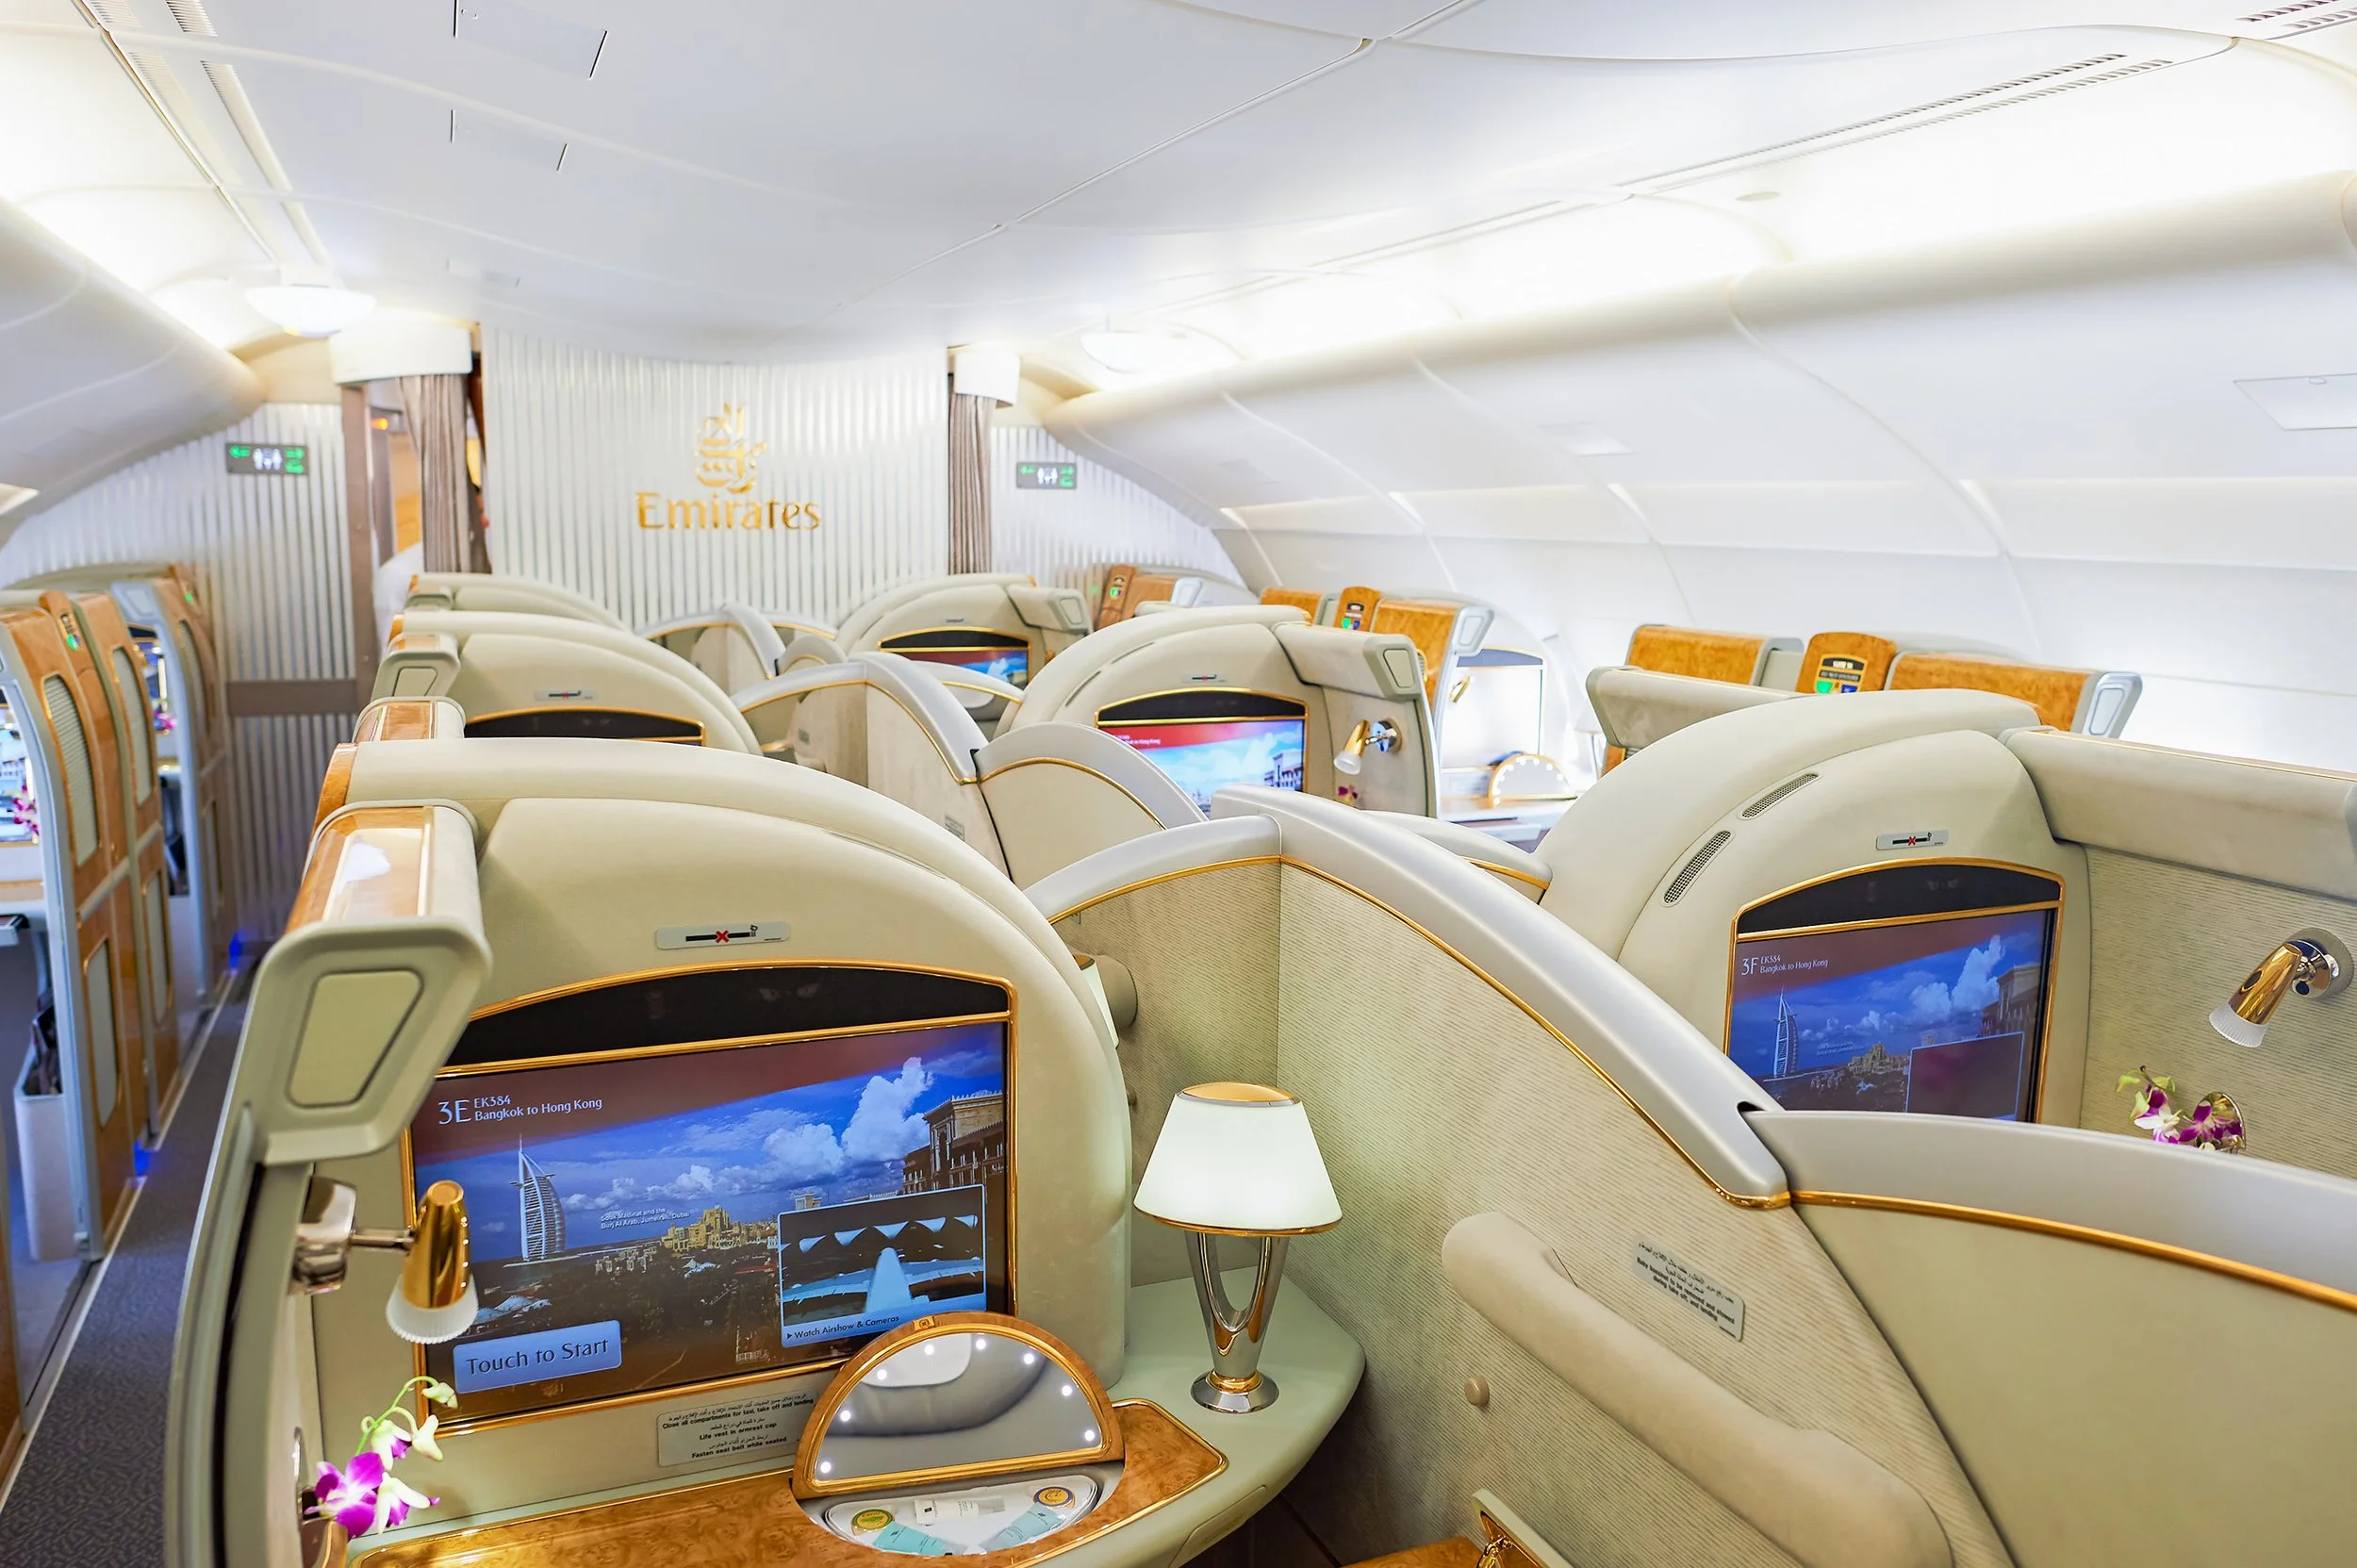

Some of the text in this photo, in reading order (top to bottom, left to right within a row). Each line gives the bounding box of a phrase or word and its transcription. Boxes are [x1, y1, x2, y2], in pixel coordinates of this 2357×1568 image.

[635, 491, 820, 530] Emirates
[1741, 957, 1759, 975] 3F
[1759, 964, 1787, 974] Bangkok
[1795, 961, 1812, 970] Hong
[1812, 959, 1829, 968] Kong
[1760, 954, 1781, 964] EK384
[474, 1094, 512, 1109] EK384
[438, 1098, 472, 1125] 3E
[474, 1098, 602, 1122] Bangkok to Hong Kong
[795, 1328, 820, 1339] Watch
[822, 1323, 855, 1334] Airshow
[865, 1315, 899, 1327] Cameras
[466, 1338, 609, 1375] Touch to Start
[689, 1413, 731, 1424] compartments
[738, 1425, 763, 1433] armrest
[765, 1436, 787, 1444] seated
